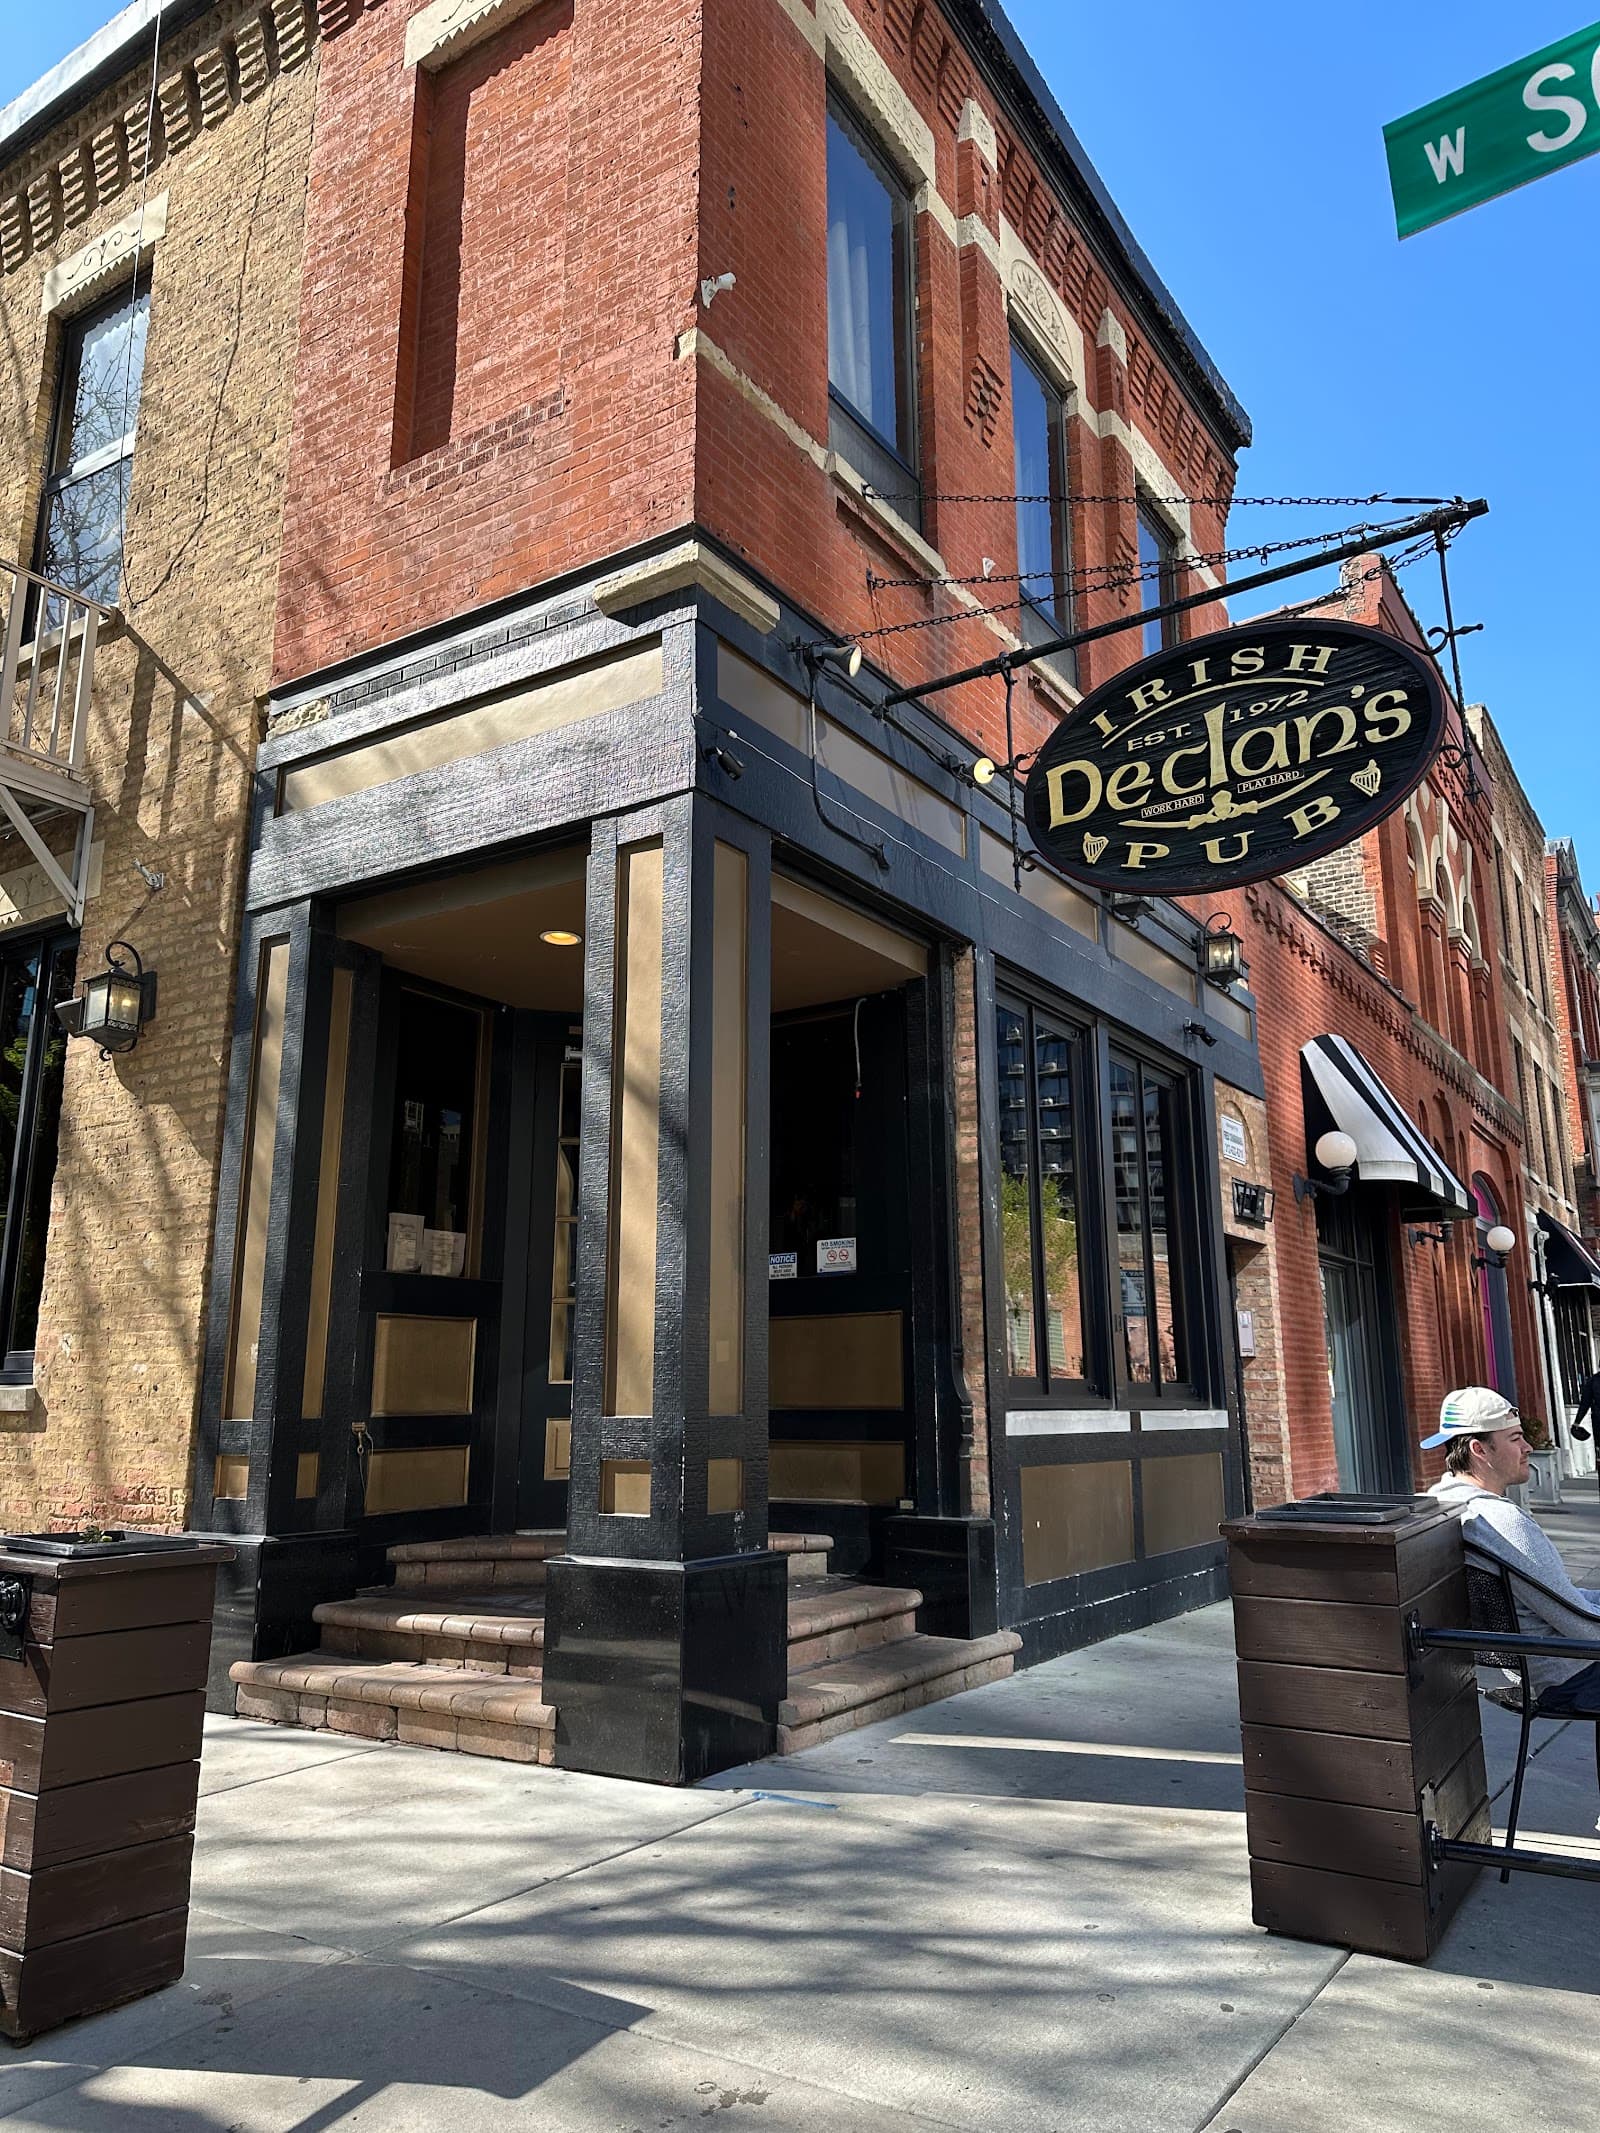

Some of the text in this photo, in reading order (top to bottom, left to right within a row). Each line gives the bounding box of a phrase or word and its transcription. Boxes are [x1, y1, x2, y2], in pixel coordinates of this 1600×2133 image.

[1423, 43, 1600, 184] W S
[1090, 645, 1339, 739] IRISH
[1127, 690, 1309, 752] EST. 1972
[1046, 685, 1412, 831] Declan's
[1242, 771, 1300, 791] PLAY HARD
[1121, 796, 1341, 868] PUB
[1144, 796, 1202, 816] WORK HARD
[770, 1255, 795, 1264] NOTICE
